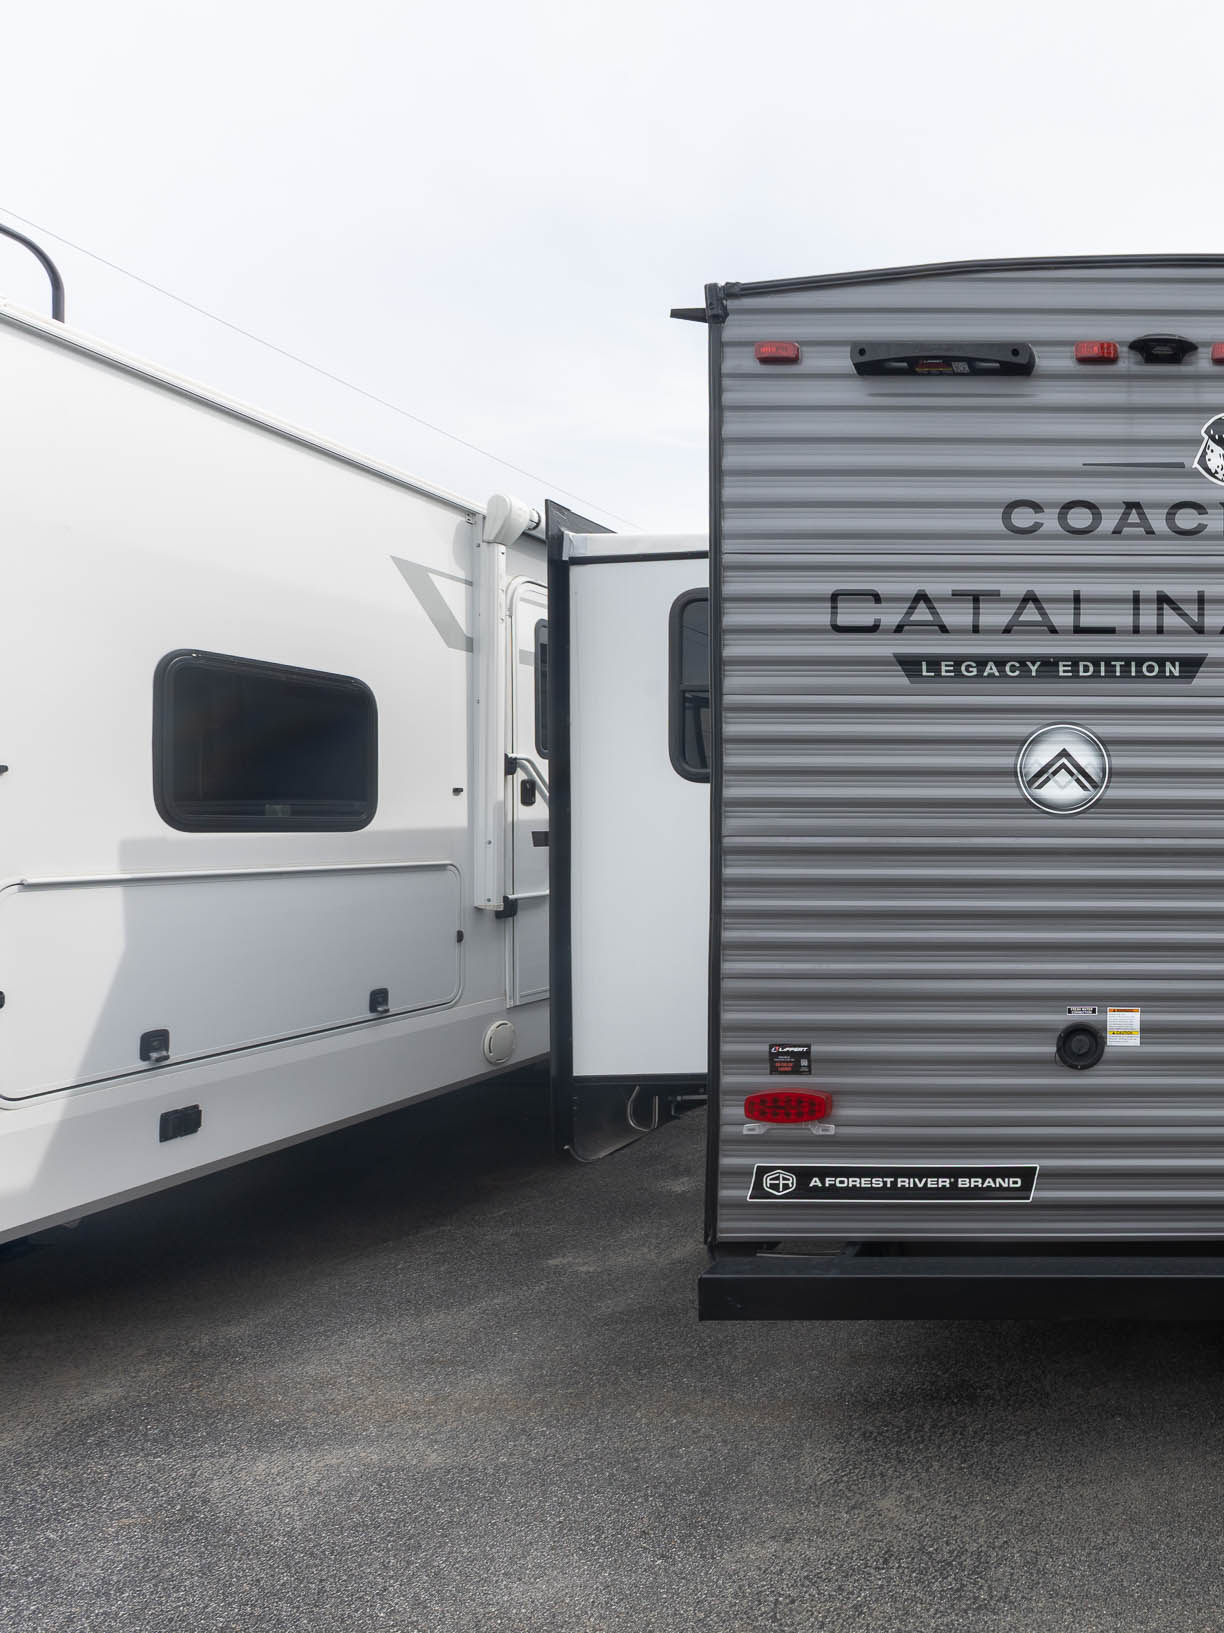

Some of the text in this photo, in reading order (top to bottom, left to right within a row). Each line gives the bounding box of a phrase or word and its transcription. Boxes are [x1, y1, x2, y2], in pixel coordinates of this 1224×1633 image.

[921, 661, 1180, 676] LEGACY EDITION
[809, 1177, 822, 1187] A
[825, 1177, 894, 1187] FOREST
[958, 1178, 1022, 1188] BRAND
